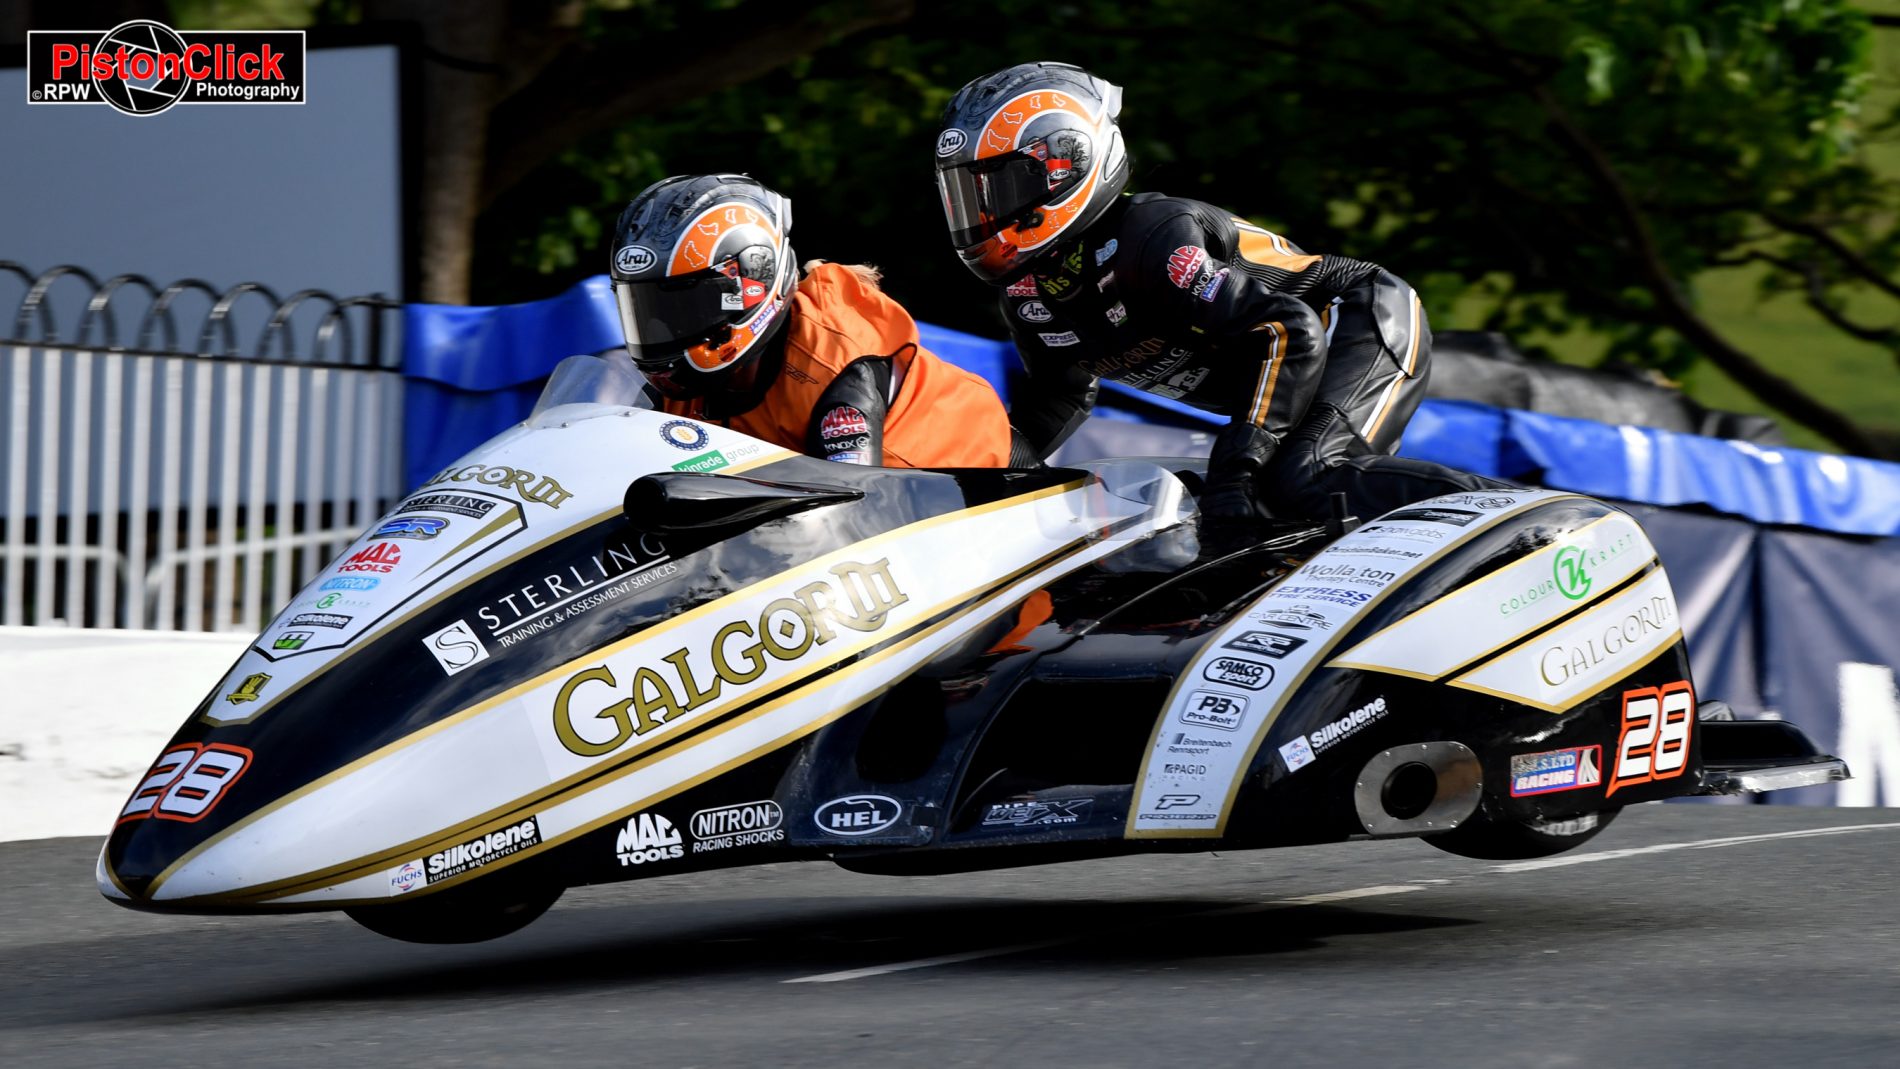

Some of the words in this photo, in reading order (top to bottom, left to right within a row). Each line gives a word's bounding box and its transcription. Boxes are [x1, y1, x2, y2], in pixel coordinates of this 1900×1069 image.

[937, 132, 961, 149] Arai
[617, 250, 649, 265] Arai
[1167, 246, 1201, 288] MAC
[1181, 249, 1206, 288] TOOLS
[821, 406, 865, 430] MAC
[823, 424, 866, 439] TOOLS
[726, 443, 760, 462] group
[824, 440, 857, 452] KNOX
[343, 542, 401, 565] MAC
[1590, 533, 1633, 567] KRAFT
[337, 563, 394, 573] TOOLS
[479, 533, 667, 630] STERLING
[1305, 574, 1349, 584] Therapy
[1350, 576, 1384, 588] Centre
[1269, 592, 1300, 600] TYRE
[1303, 594, 1361, 608] SERVICE
[1276, 586, 1373, 602] EXPRESS
[1500, 579, 1554, 615] COLOUR
[497, 617, 554, 648] TRAINING
[555, 611, 566, 623] &
[565, 581, 637, 619] ASSESSMENT
[632, 561, 678, 588] SERVICES
[1278, 613, 1334, 631] CENTRE
[1216, 660, 1264, 677] SAMCO
[1198, 696, 1232, 714] PB
[1186, 711, 1231, 725] Pro-Bolt
[1614, 687, 1693, 784] 28
[1174, 764, 1207, 775] PAGID
[1515, 769, 1575, 790] RACING
[119, 746, 249, 819] 28
[697, 804, 770, 837] NITRON
[831, 810, 888, 828] HEL
[616, 813, 683, 853] MAC
[692, 836, 734, 854] RACING
[735, 829, 785, 847] SHOCKS
[429, 865, 467, 883] SUPERIOR
[468, 846, 518, 869] MOTORCYCLE
[520, 837, 538, 848] OILS
[616, 844, 685, 866] TOOLS
[391, 869, 423, 887] FUCHS
